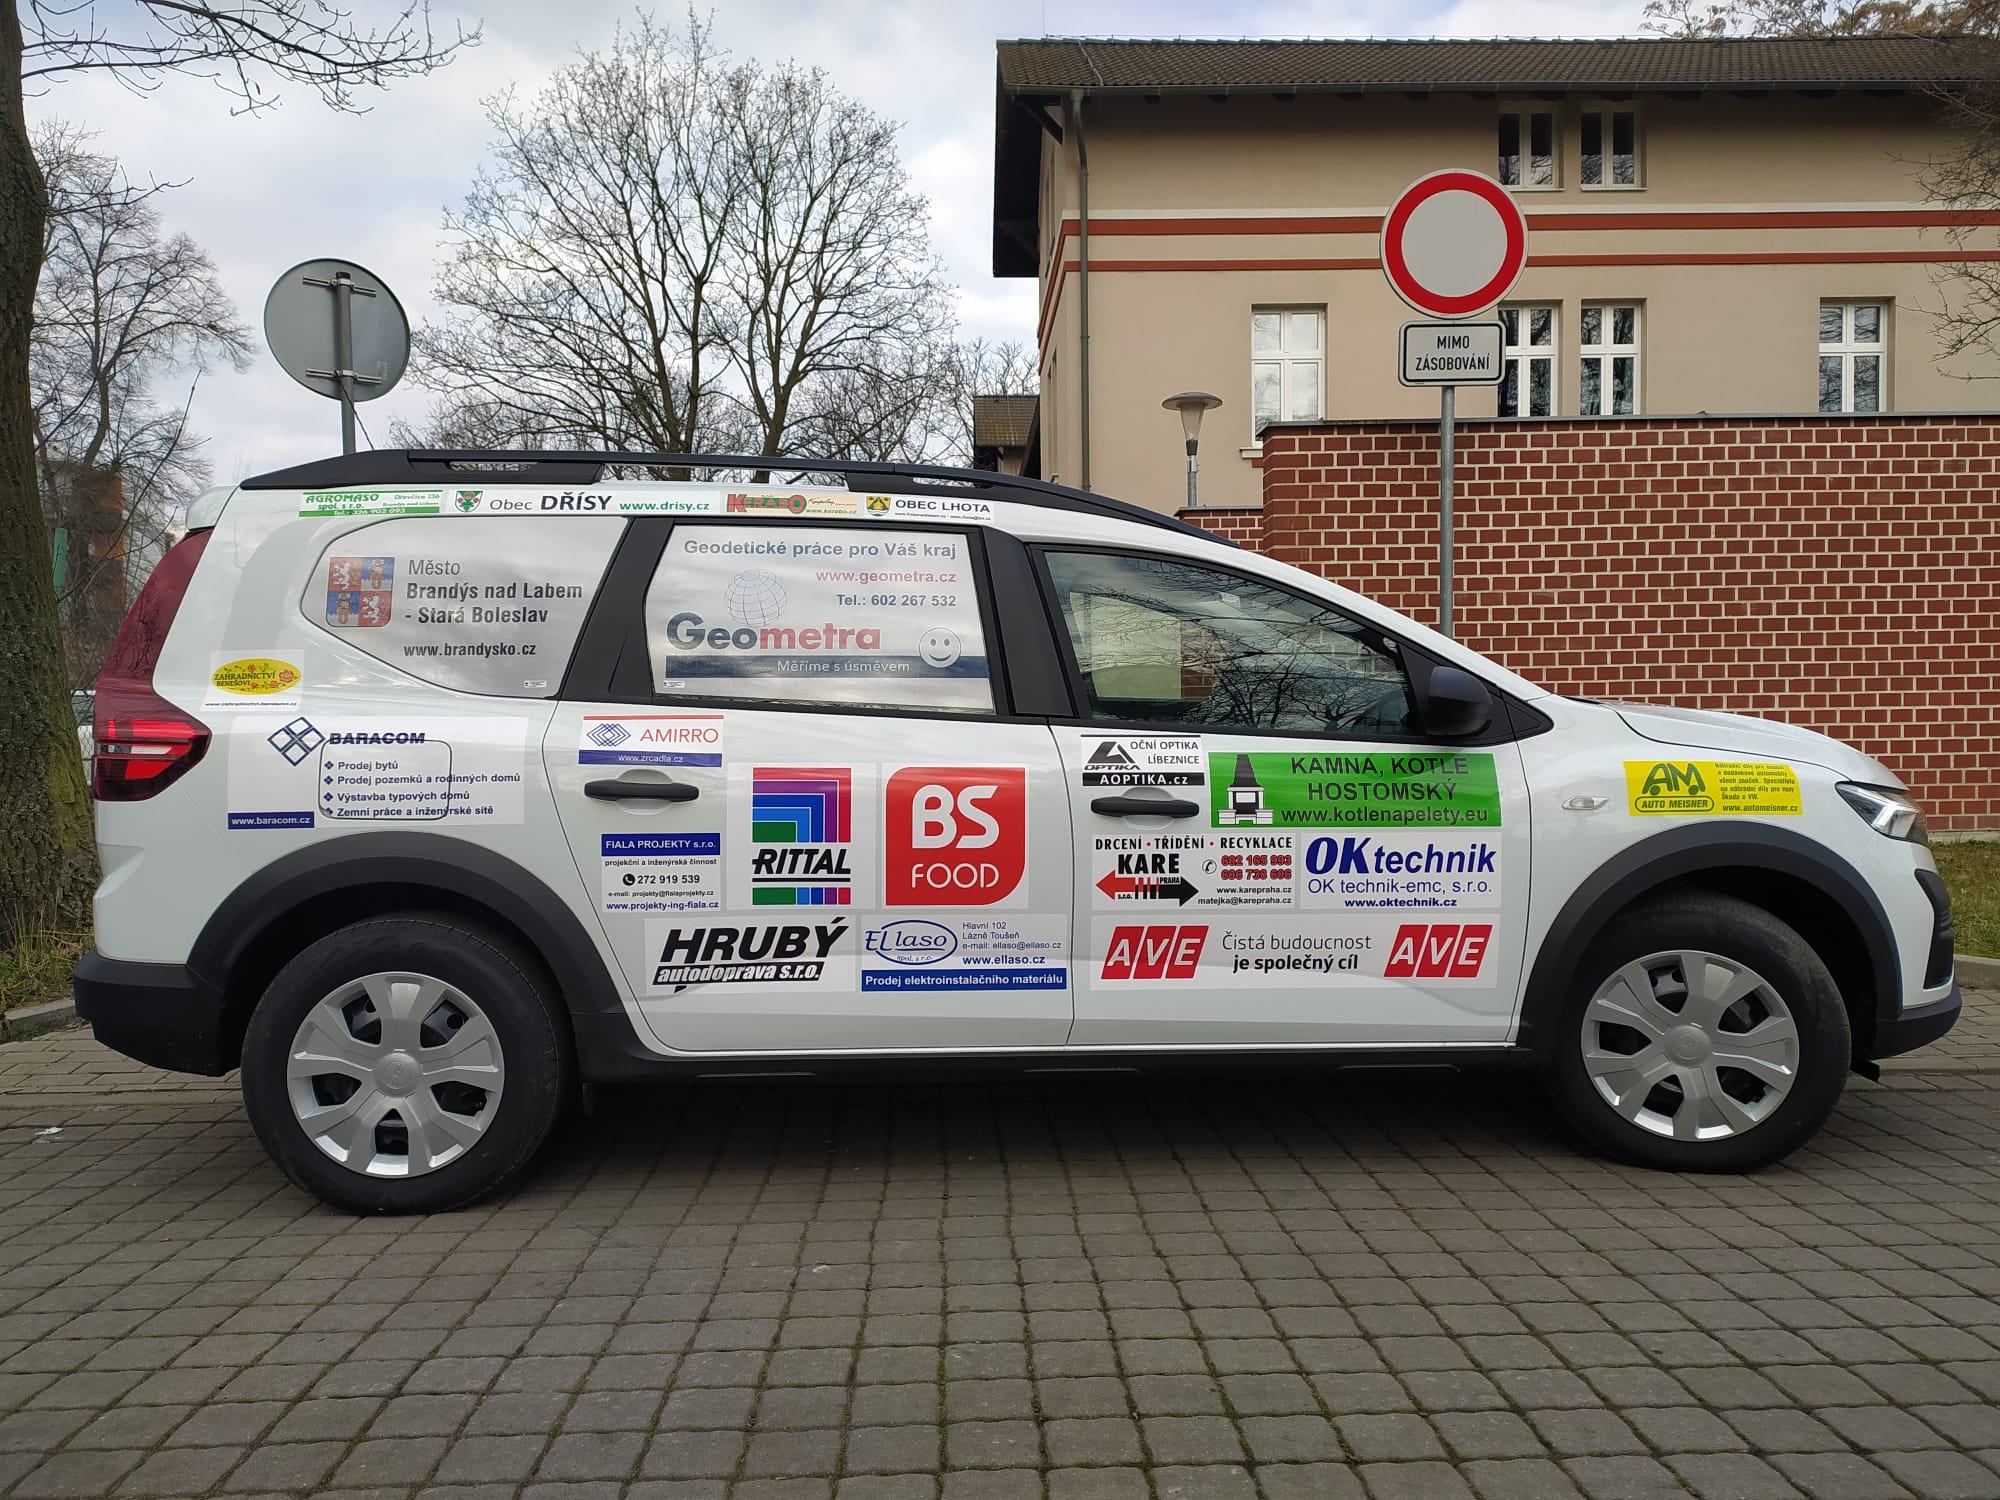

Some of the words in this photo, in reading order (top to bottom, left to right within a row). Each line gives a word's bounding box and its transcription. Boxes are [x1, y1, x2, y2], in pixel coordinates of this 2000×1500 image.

[1437, 335, 1470, 348] MIMO
[1416, 353, 1490, 370] ZÁSOBOVÁNÍ
[306, 494, 379, 503] AGROMASO
[490, 498, 532, 510] Obec
[541, 492, 612, 510] DŘÍSY
[727, 494, 806, 514] KERABO
[619, 500, 710, 512] www.drisy.cz
[896, 500, 936, 510] OBEC
[942, 502, 990, 513] LHOTA
[684, 540, 787, 555] Geodetické
[793, 541, 842, 557] práce
[850, 544, 878, 558] pro
[884, 542, 917, 556] Váš
[924, 544, 956, 559] kraj
[409, 559, 461, 576] Město
[816, 570, 956, 584] www.geometra.cz
[406, 582, 478, 601] Brandýs
[484, 583, 517, 598] nad
[523, 583, 582, 598] Labem
[836, 594, 866, 606] Tel.:
[871, 594, 896, 606] 602
[902, 594, 927, 606] 267
[931, 595, 956, 607] 532
[418, 607, 465, 623] Stará
[472, 606, 548, 622] Boleslav
[666, 612, 880, 650] Geometra
[404, 642, 536, 658] www.brandysko.cz
[777, 659, 831, 672] Měříme
[834, 663, 842, 672] s
[844, 660, 910, 672] úsměvem
[214, 671, 276, 680] ZAHRADNICTVÍ
[329, 732, 425, 745] BARACOM
[640, 728, 718, 743] AMIRRO
[1130, 740, 1156, 750] OČNÍ
[1160, 741, 1199, 750] OPTIKA
[618, 754, 684, 763] www.zrcadia.cz
[1148, 754, 1200, 764] LÍBEZNICE
[338, 761, 372, 771] Prodej
[376, 760, 398, 771] bytů
[1291, 758, 1384, 777] KAMNA,
[1391, 758, 1469, 775] KOTLE
[337, 775, 372, 785] Prodej
[375, 774, 422, 785] pozemků
[436, 774, 488, 785] rodinných
[491, 773, 520, 782] domů
[1100, 774, 1188, 785] AOPTIKA.cz
[1642, 763, 1706, 796] AM
[1308, 779, 1457, 800] HOSTOMSKÝ
[337, 791, 385, 803] Výstavba
[389, 790, 437, 802] typových
[440, 790, 470, 800] domů
[1642, 800, 1665, 808] AUTO
[1669, 799, 1708, 808] MEISNER
[337, 807, 369, 817] Zemní
[373, 807, 402, 818] práce
[415, 806, 471, 817] inženýrské
[474, 806, 493, 815] sítě
[912, 784, 999, 848] BS
[1280, 806, 1488, 825] www.kotlenapelety.eu
[232, 816, 310, 825] www.baracom.cz
[638, 840, 690, 848] PROJEKTY
[1096, 836, 1142, 850] DRCENÍ
[1154, 835, 1204, 849] TŘÍDĚNÍ
[1220, 836, 1292, 849] RECYKLACE
[605, 858, 639, 866] projekční
[648, 858, 688, 866] inženýrská
[752, 849, 850, 874] RITTAL
[1118, 854, 1179, 874] KARE
[637, 875, 656, 884] 272
[659, 875, 678, 884] 919
[682, 874, 700, 883] 539
[912, 863, 999, 888] FOOD
[1308, 879, 1334, 894] OK
[1340, 878, 1446, 895] technik-emc,
[1452, 882, 1492, 893] s.r.o.
[632, 889, 714, 898] projekty@fialaprojekty.cz
[606, 901, 719, 910] www.projekty-ing-fiala.cz
[1198, 897, 1291, 905] matejka@karepraha.cz
[1345, 897, 1457, 908] www.oktechnik.cz
[660, 916, 849, 964] HRUBÝ
[962, 931, 988, 940] Lázně
[991, 932, 1020, 940] Toušeň
[1222, 931, 1264, 951] Čistá
[1271, 934, 1372, 951] budoucnost
[993, 941, 1061, 950] ellaso@ellaso.cz
[1390, 937, 1483, 966] AVE
[1107, 938, 1200, 967] AVE
[963, 955, 1046, 964] www.ellaso.cz
[1233, 954, 1250, 973] je
[1254, 954, 1334, 973] společný
[1338, 954, 1358, 970] cíl
[657, 964, 776, 982] autodoprava
[779, 964, 820, 979] s.r.o.
[866, 976, 902, 987] Prodej
[905, 973, 1009, 985] elektroinstalačního
[1012, 973, 1063, 984] materiálu
